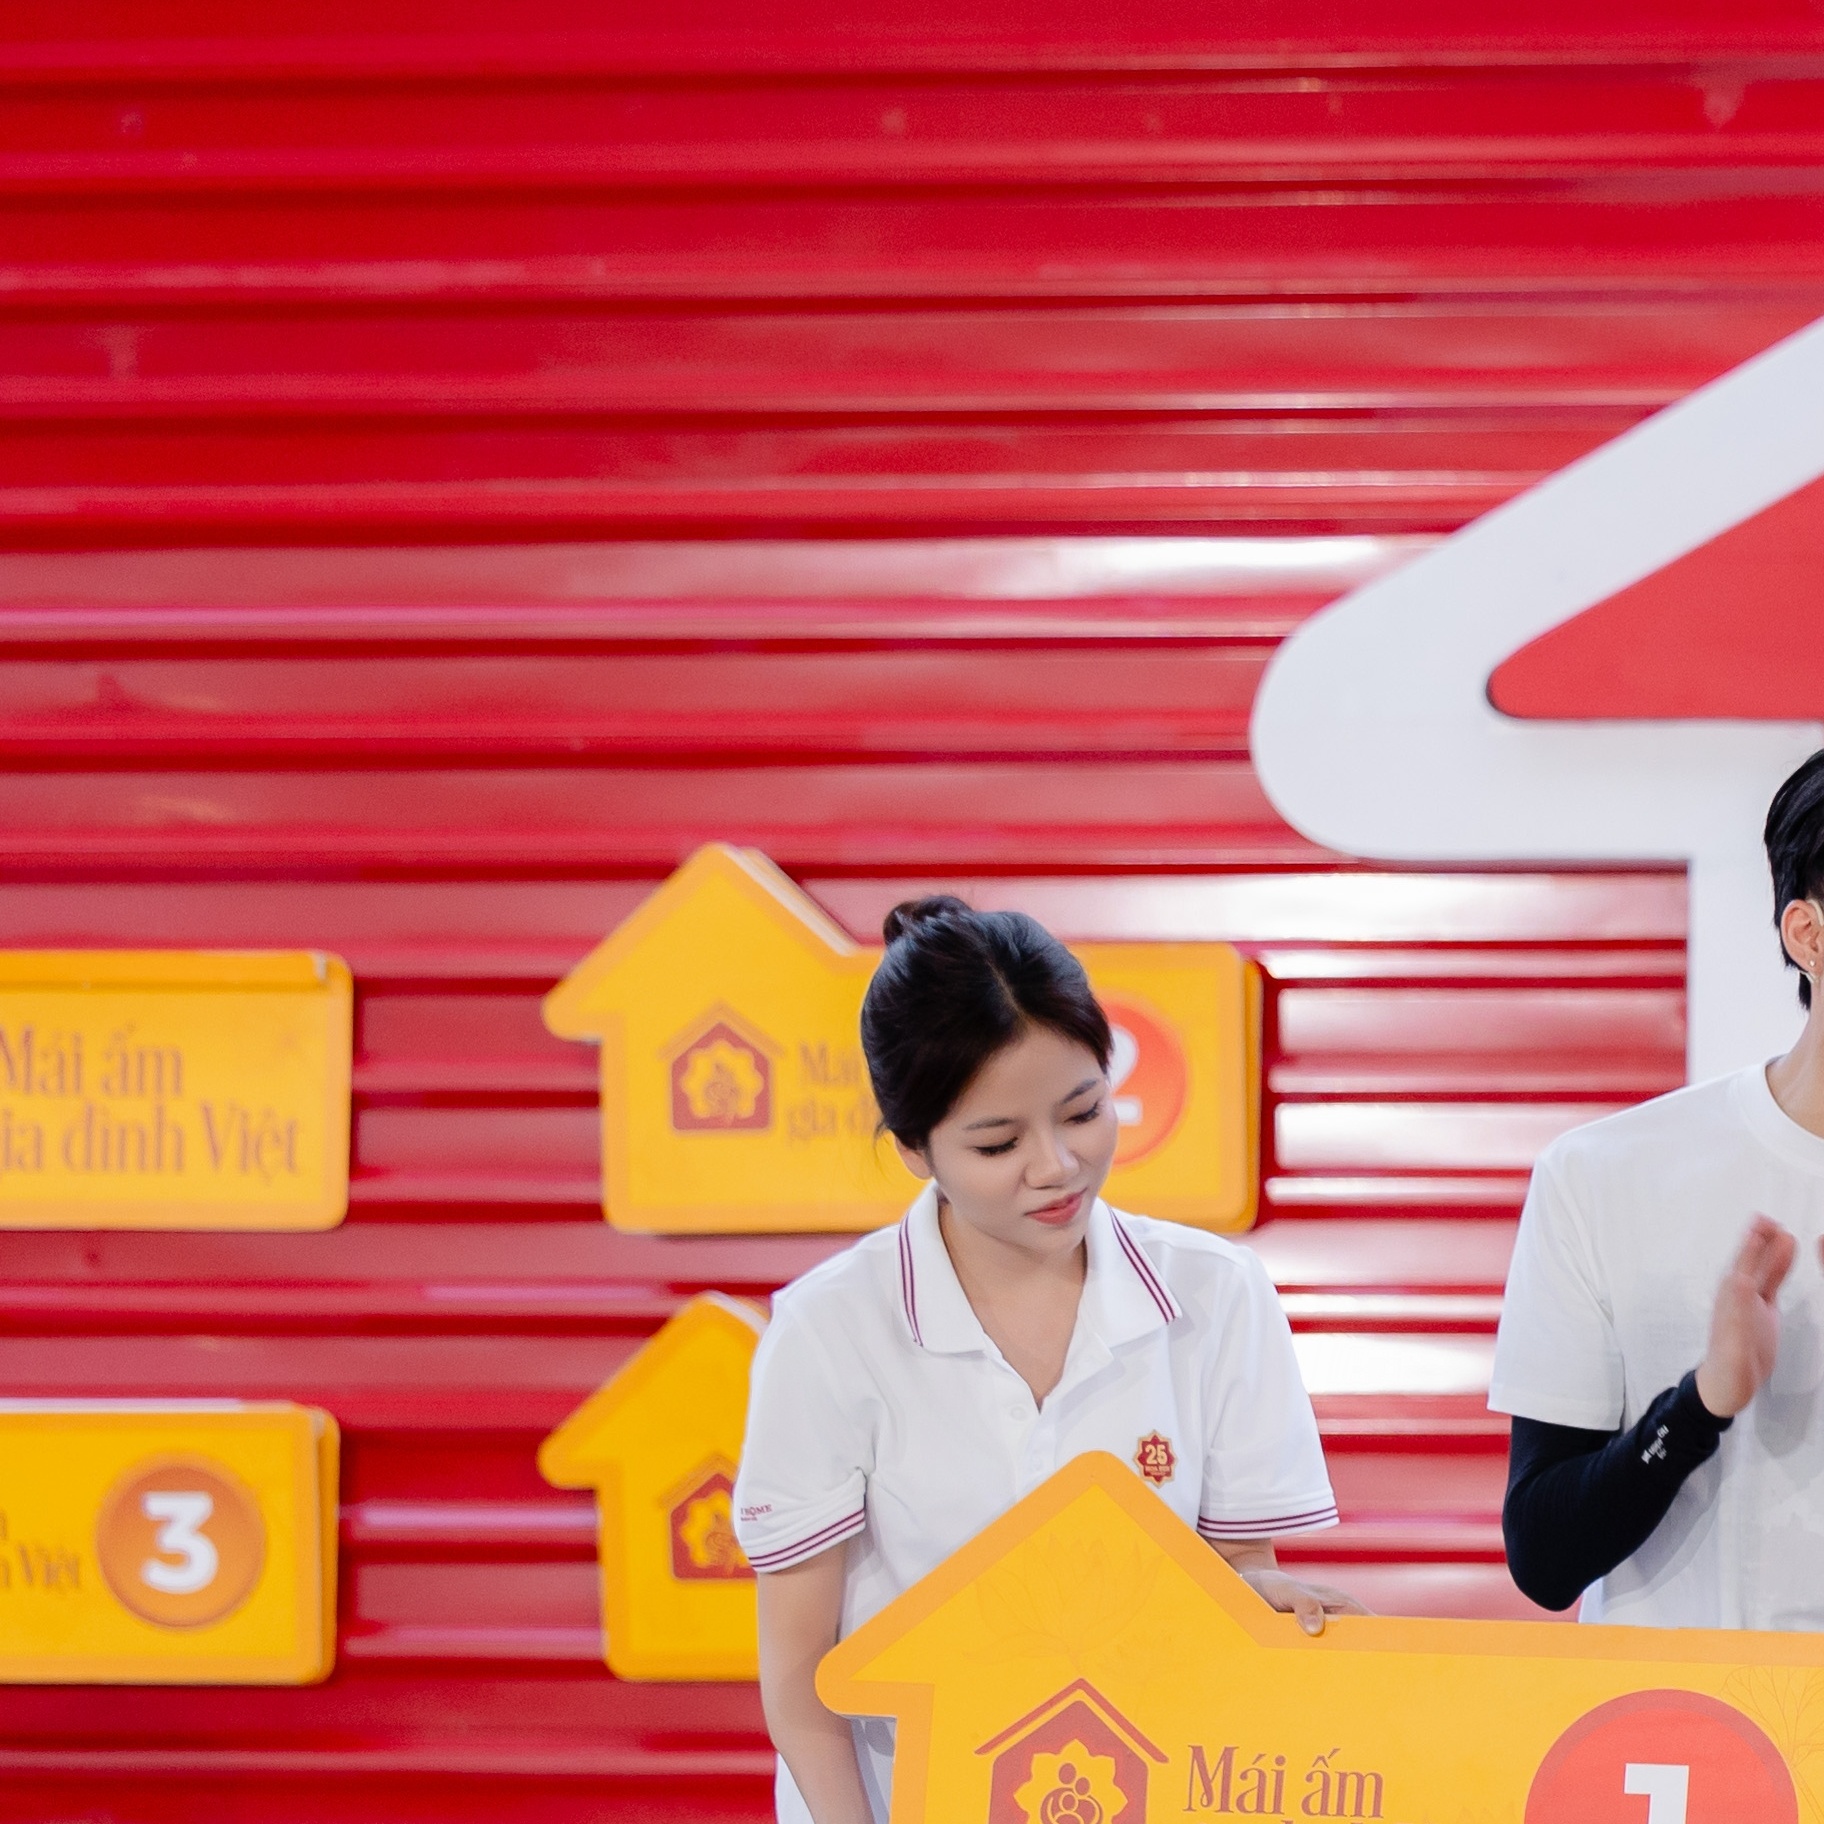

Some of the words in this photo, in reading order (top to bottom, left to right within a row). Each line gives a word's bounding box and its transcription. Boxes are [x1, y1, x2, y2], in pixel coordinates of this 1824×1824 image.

[1144, 1443, 1169, 1466] 25
[140, 1490, 219, 1596] 3
[1182, 1744, 1288, 1816] Mái
[1300, 1747, 1385, 1820] ấm
